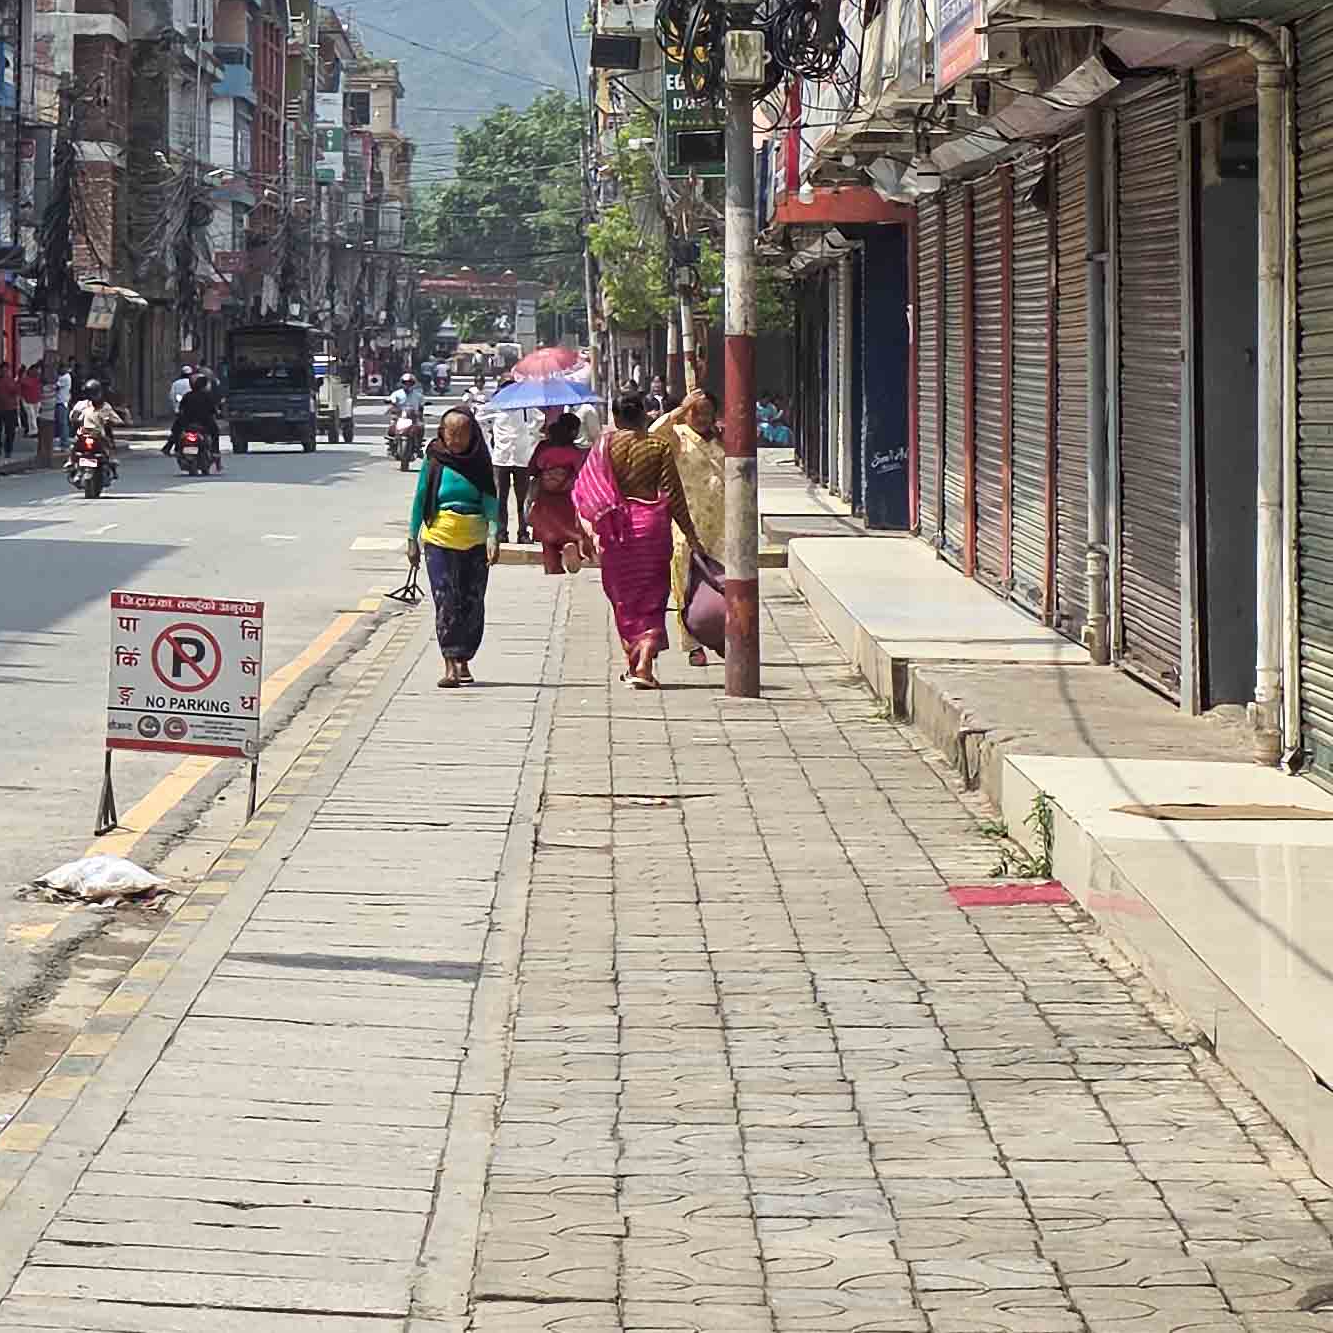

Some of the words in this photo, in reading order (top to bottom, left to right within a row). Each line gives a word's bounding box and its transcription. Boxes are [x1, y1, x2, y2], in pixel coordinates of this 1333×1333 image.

[172, 637, 206, 678] P
[145, 696, 166, 709] NO
[169, 697, 230, 713] PARKING
